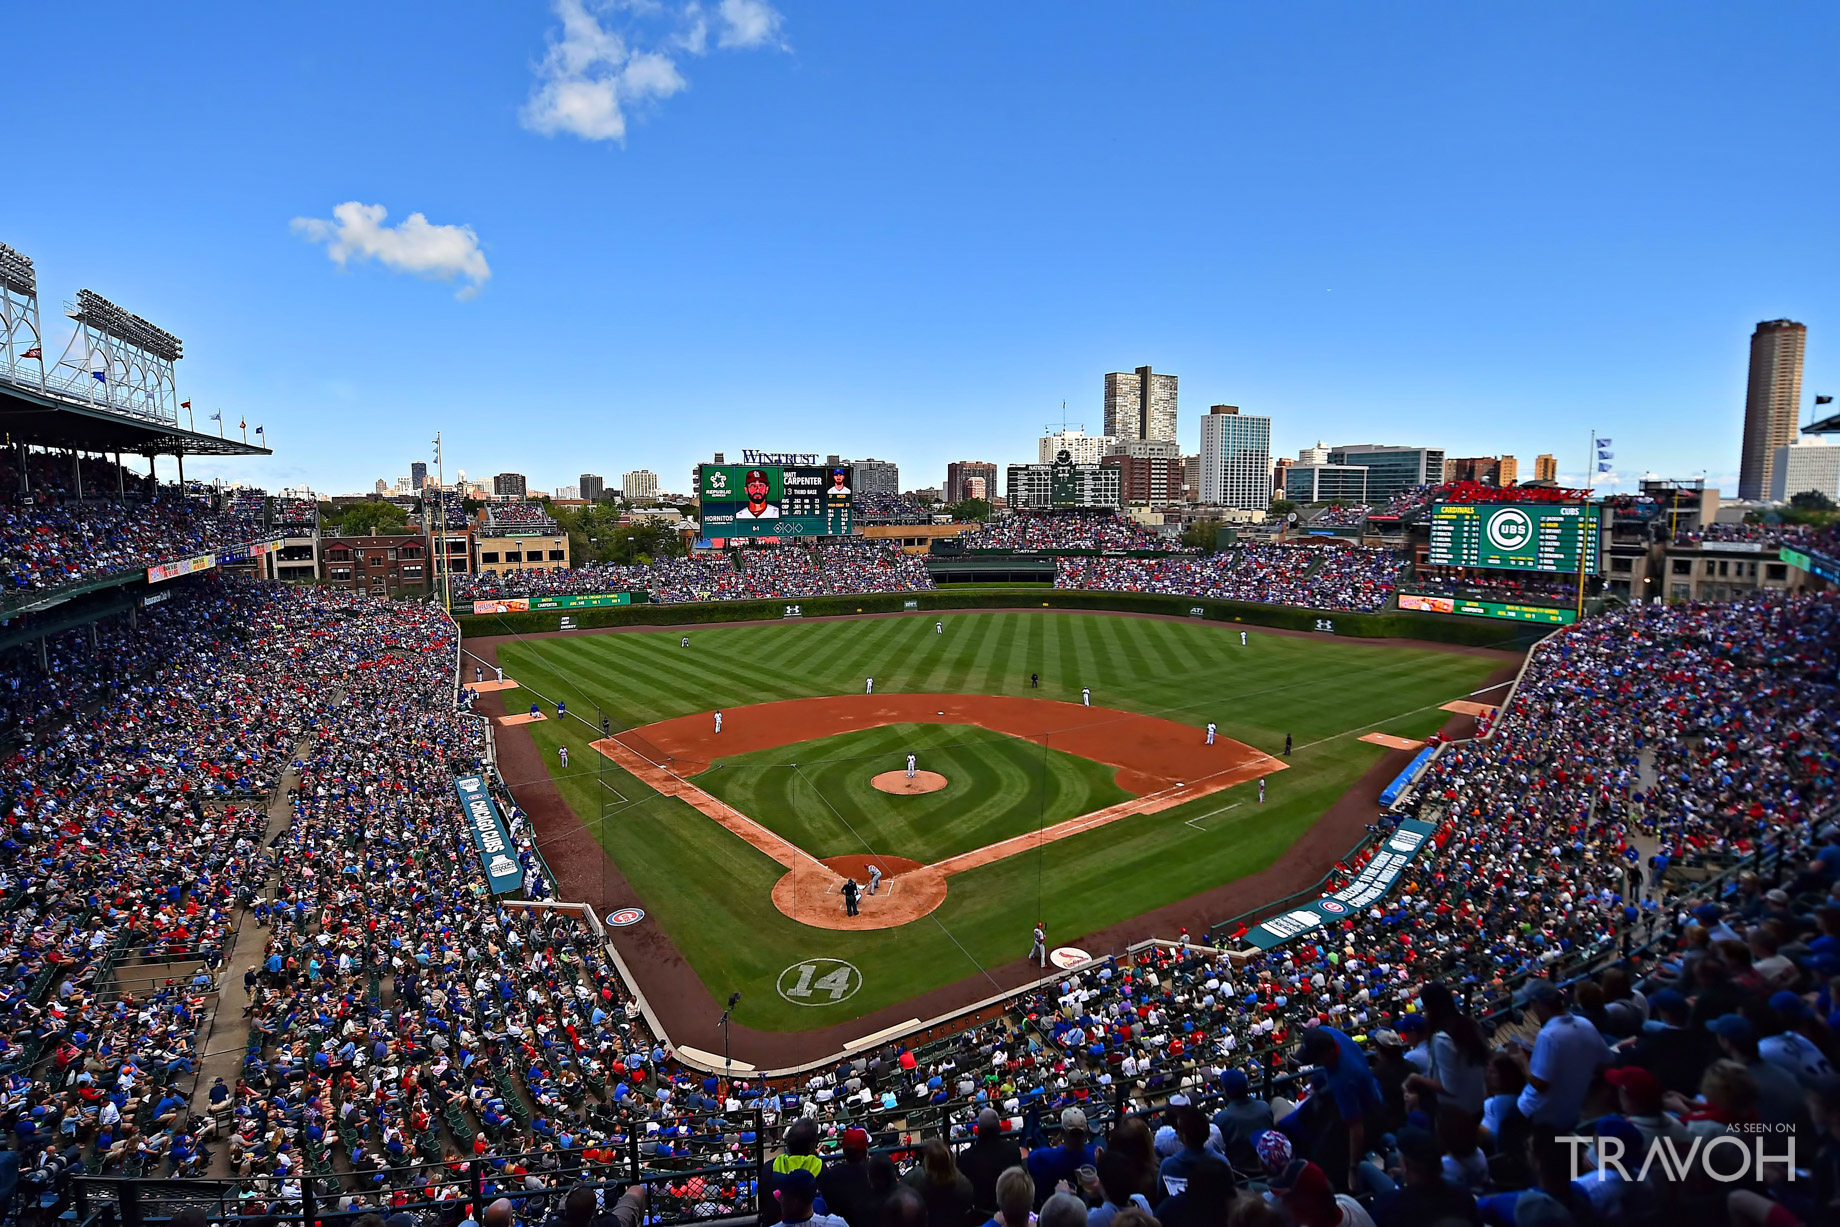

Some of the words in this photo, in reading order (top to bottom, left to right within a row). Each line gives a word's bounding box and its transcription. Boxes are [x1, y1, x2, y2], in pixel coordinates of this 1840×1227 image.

[742, 449, 819, 465] WINTRUST
[1443, 480, 1595, 502] Budweiser
[469, 800, 496, 832] CHICAGO
[481, 830, 505, 853] CUBS
[1359, 875, 1374, 883] TO
[1363, 867, 1380, 877] THE
[1332, 881, 1369, 901] WELCOME
[1348, 886, 1383, 908] CONFINES
[1372, 880, 1387, 889] OF
[786, 964, 852, 999] 14
